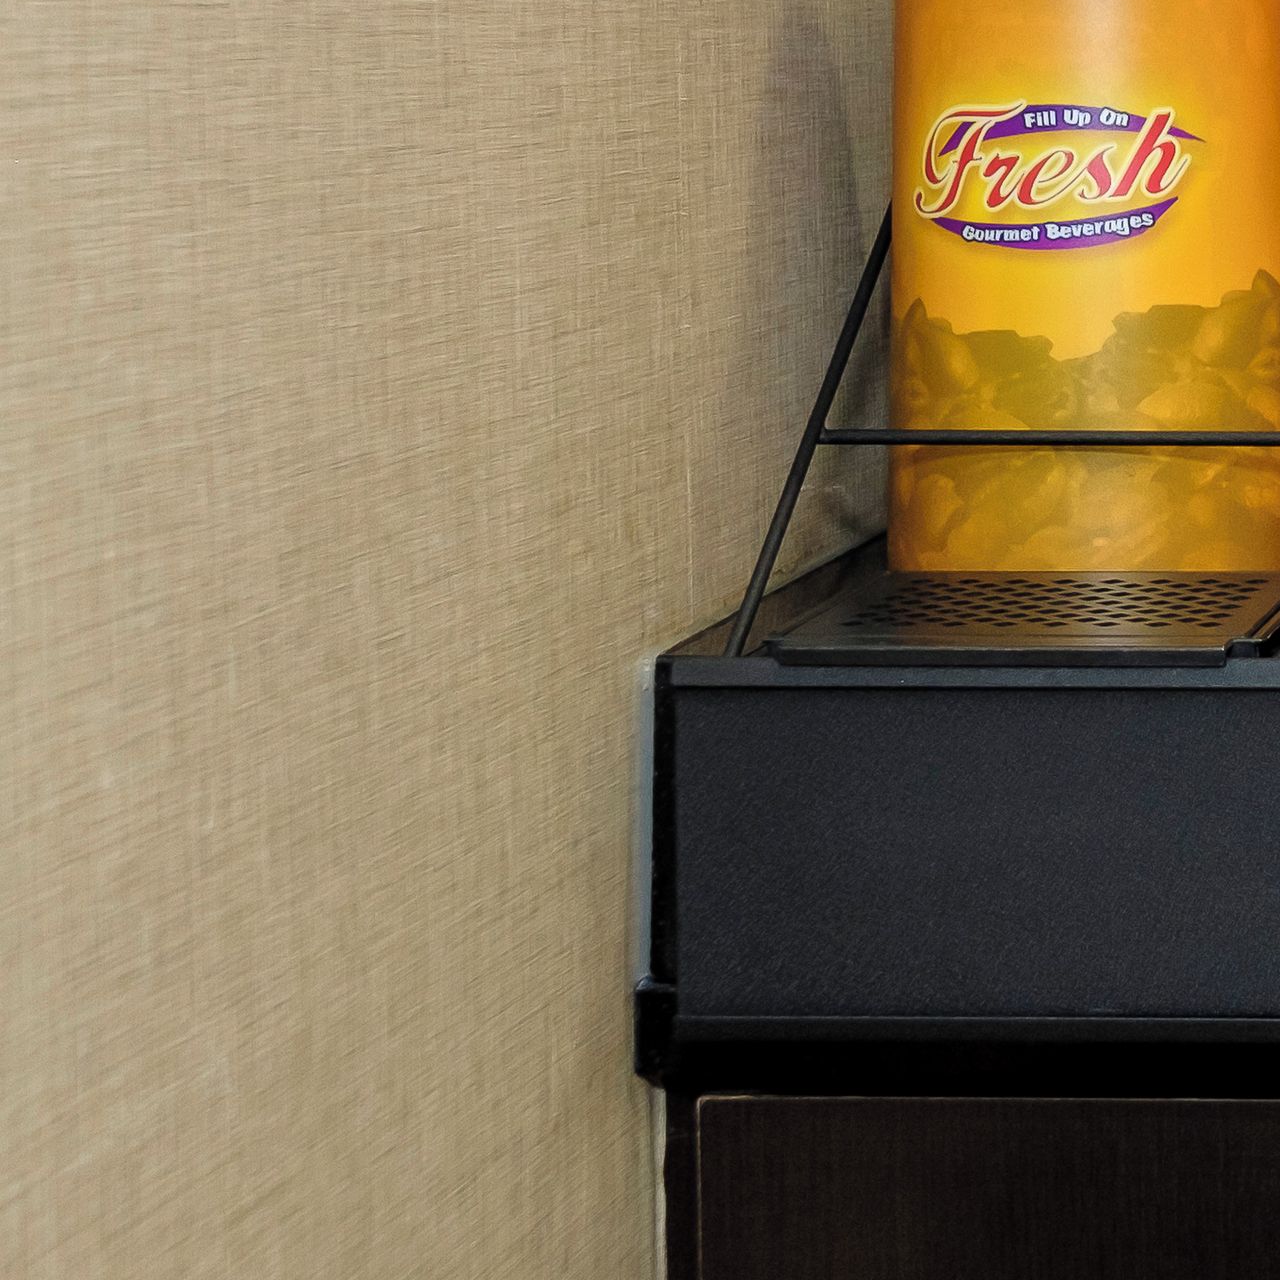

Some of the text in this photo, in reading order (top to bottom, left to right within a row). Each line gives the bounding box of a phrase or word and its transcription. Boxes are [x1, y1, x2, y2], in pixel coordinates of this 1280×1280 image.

[1024, 108, 1129, 128] Fill Up On
[915, 100, 1191, 218] Fresh
[963, 212, 1154, 242] Gourmet Beverages
